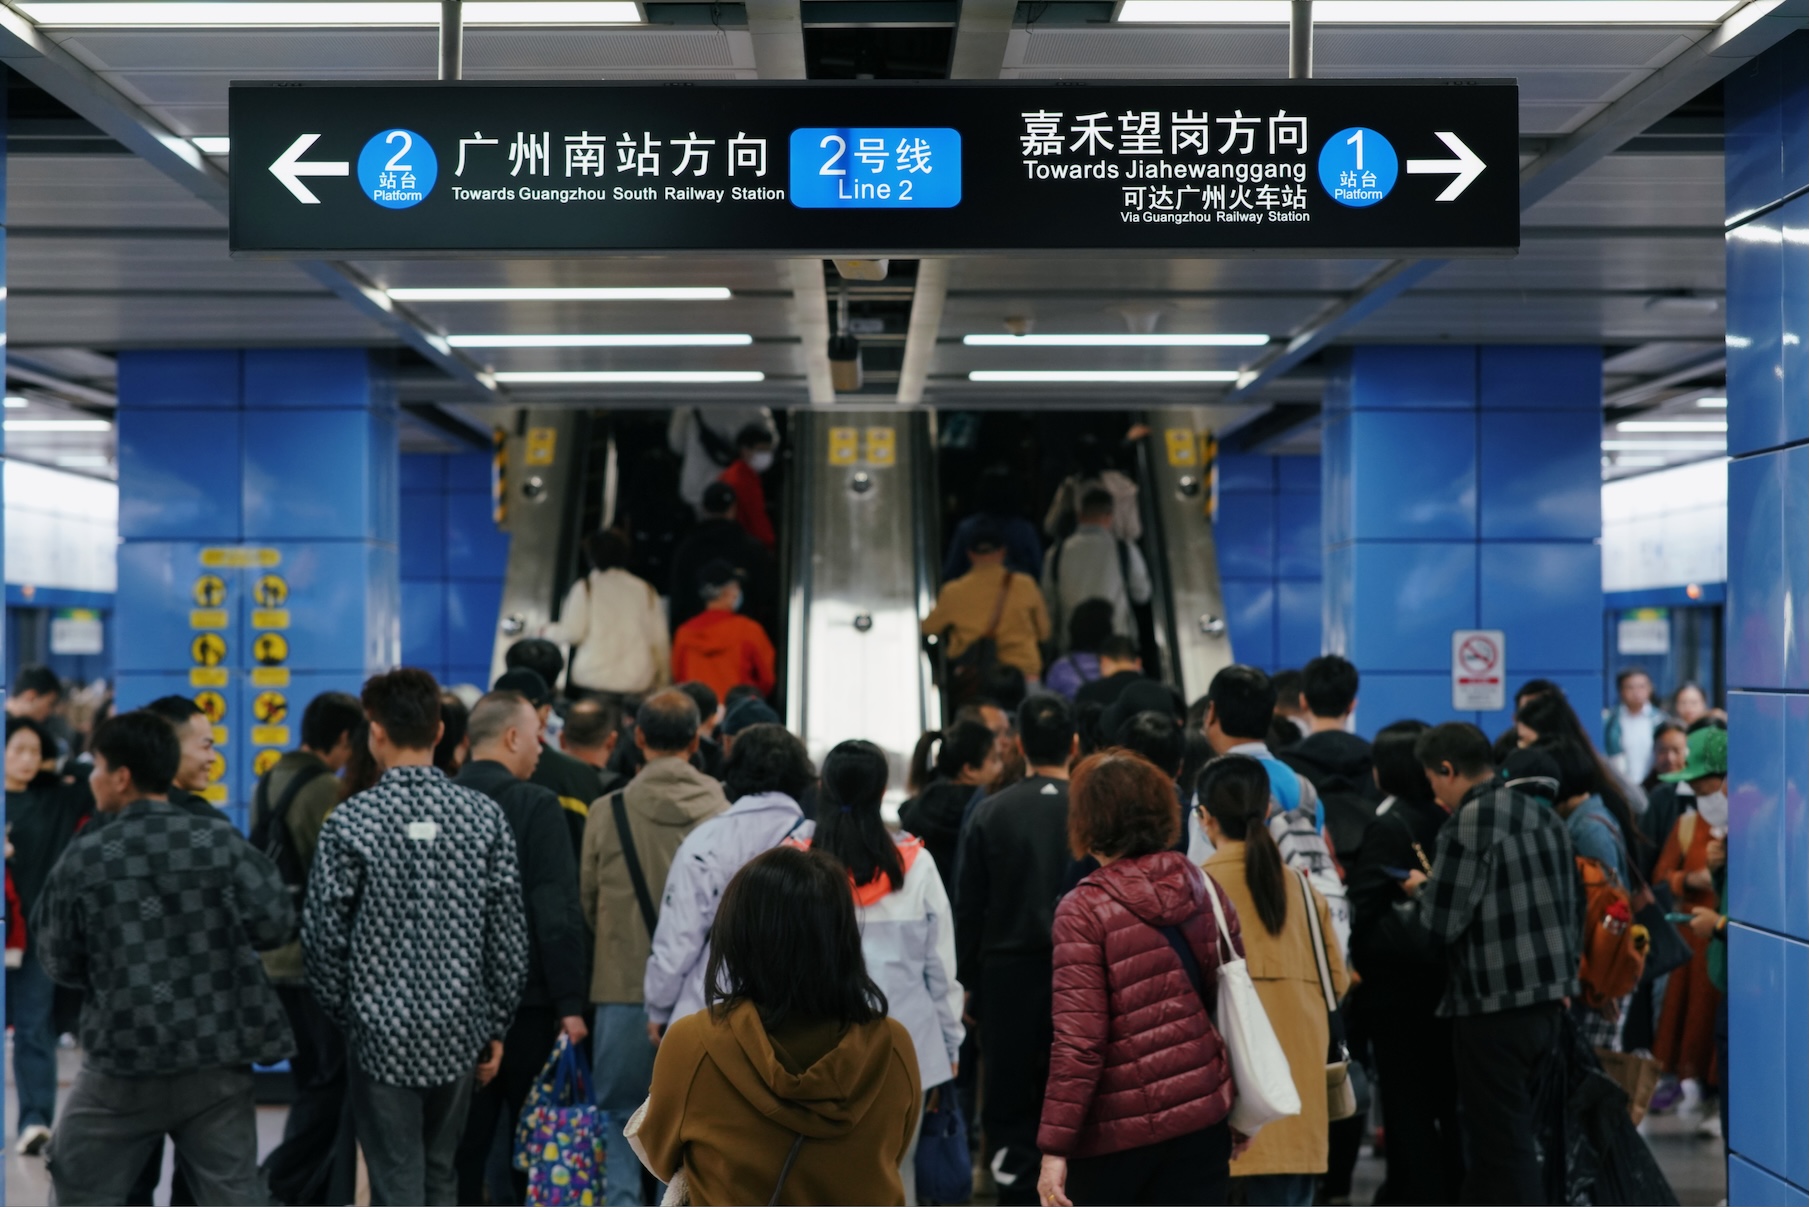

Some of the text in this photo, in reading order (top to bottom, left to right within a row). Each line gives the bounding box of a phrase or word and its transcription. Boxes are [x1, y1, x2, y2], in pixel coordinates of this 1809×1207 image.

[1019, 109, 1308, 157] 嘉禾望岗方向
[384, 130, 413, 172] 2
[454, 130, 767, 178] 广州南站方向
[1347, 129, 1363, 170] 1
[379, 171, 417, 190] 站台
[1022, 159, 1306, 183] Towards Jiahewanggang
[1340, 170, 1377, 188] 站台
[373, 189, 423, 201] Platform
[451, 186, 785, 204] Towards Guangzhou South Railway Station
[839, 178, 913, 201] Line 2
[1121, 183, 1308, 211] 可达广州火车站
[1334, 188, 1383, 200] Platform
[1120, 210, 1310, 225] Via Guangzhou Railway Station
